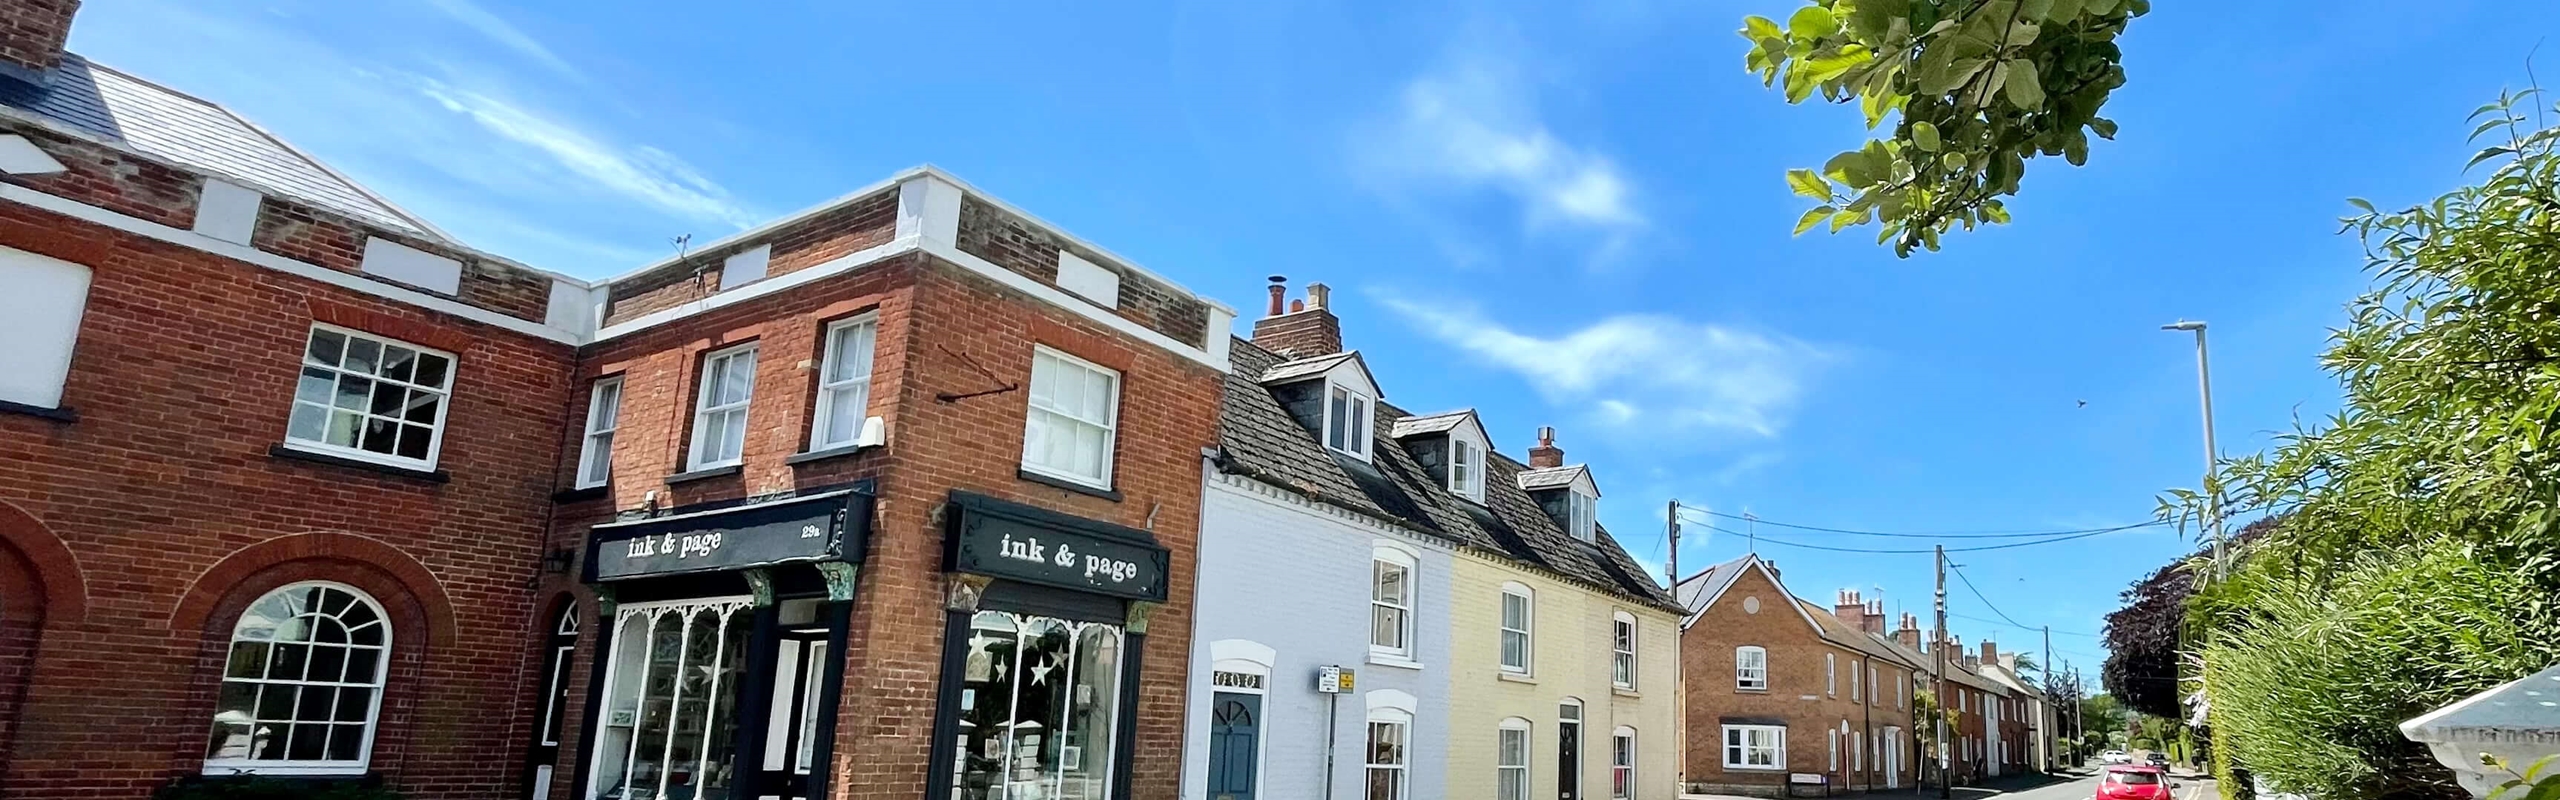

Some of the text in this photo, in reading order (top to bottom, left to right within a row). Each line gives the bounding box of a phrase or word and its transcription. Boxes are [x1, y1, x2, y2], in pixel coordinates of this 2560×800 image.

[627, 532, 722, 558] ink & page
[1000, 533, 1137, 582] ink & page
